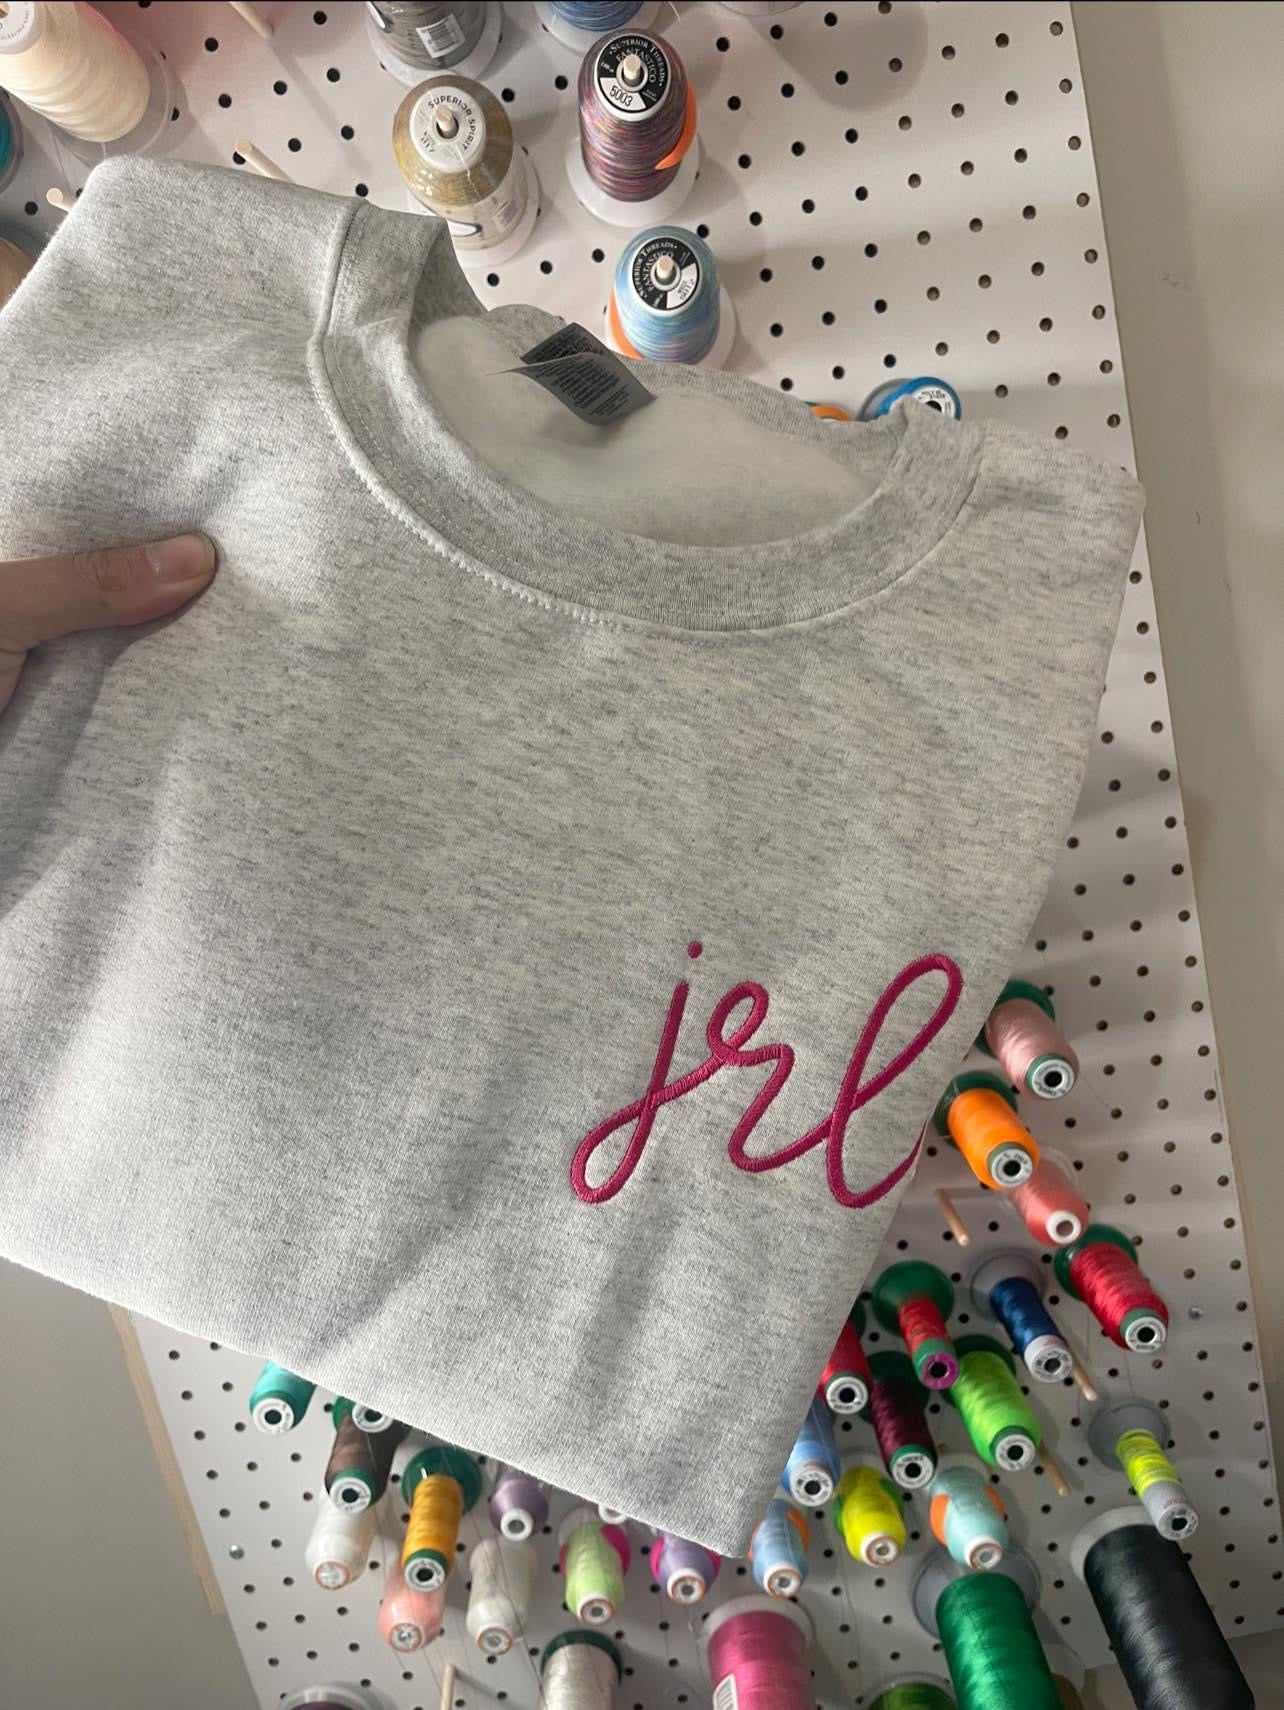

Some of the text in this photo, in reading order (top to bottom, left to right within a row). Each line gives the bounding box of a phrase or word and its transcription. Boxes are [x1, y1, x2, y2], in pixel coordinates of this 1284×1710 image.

[610, 39, 666, 82] SUPERIOR THREADS
[609, 85, 633, 107] 5003
[427, 95, 473, 116] SUPERIOR
[462, 118, 477, 151] SPIRIT
